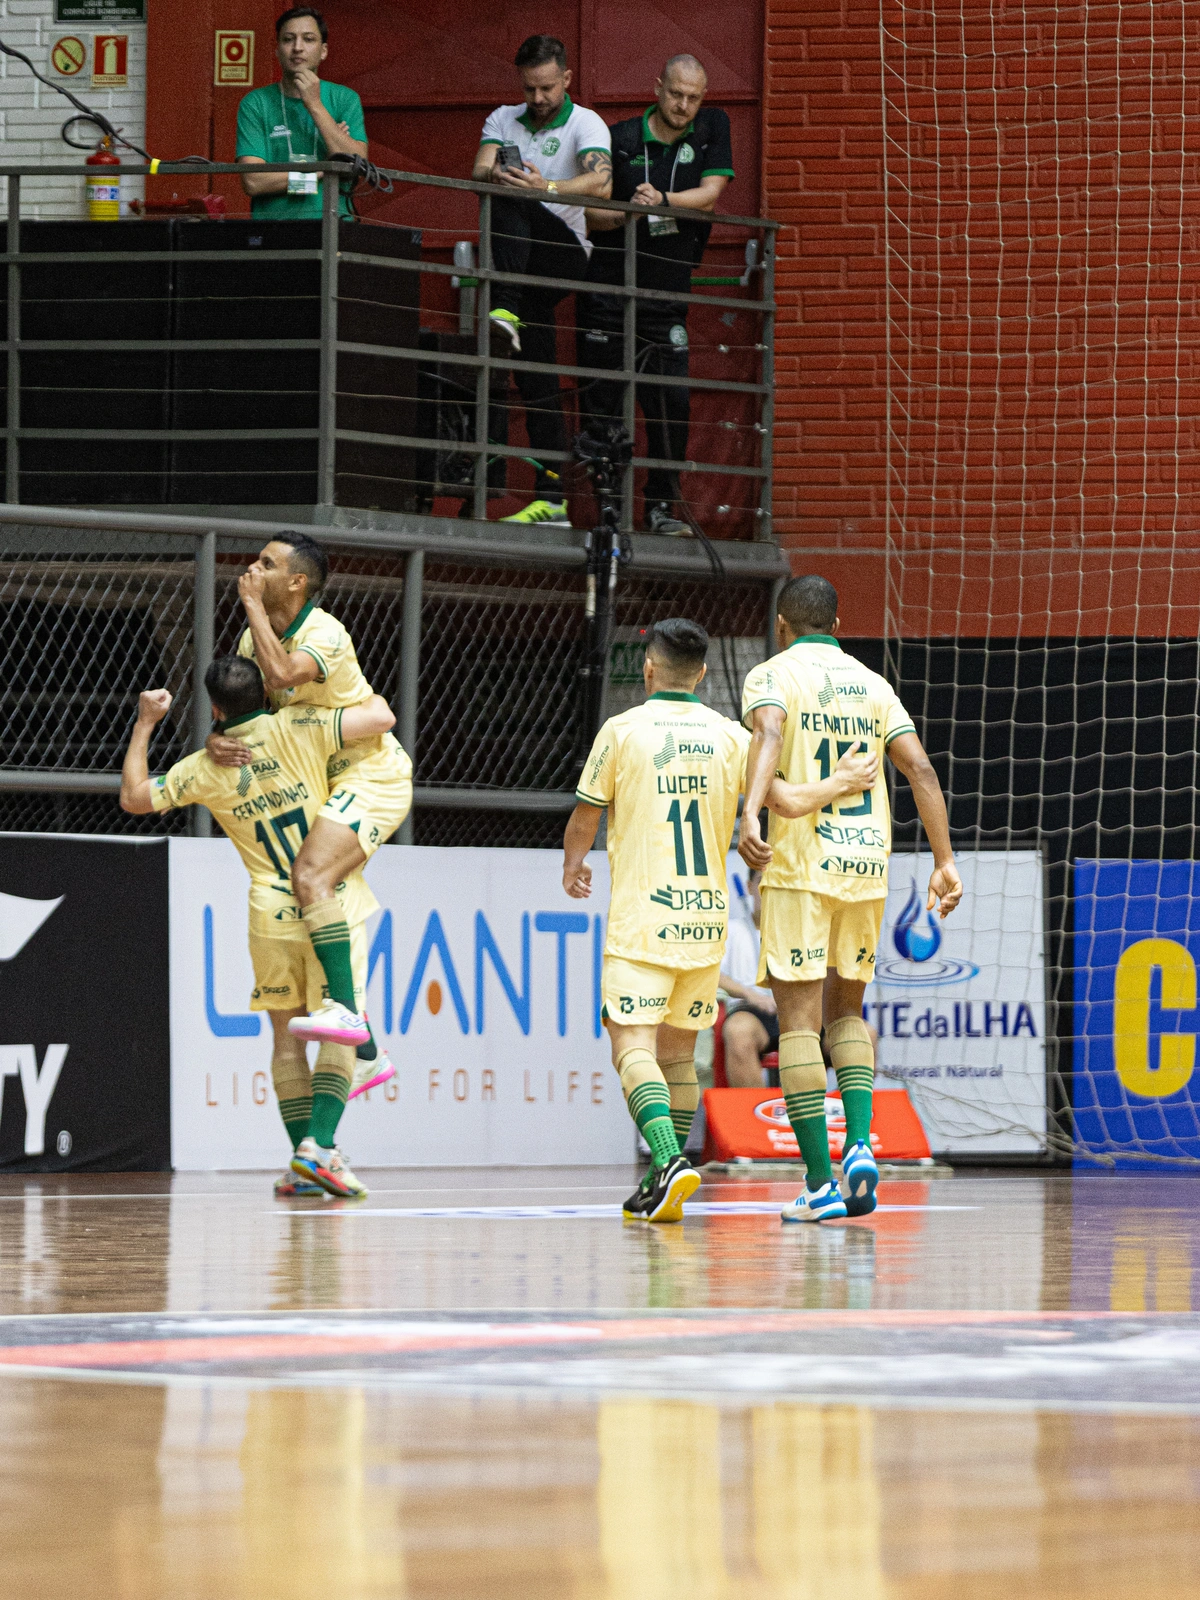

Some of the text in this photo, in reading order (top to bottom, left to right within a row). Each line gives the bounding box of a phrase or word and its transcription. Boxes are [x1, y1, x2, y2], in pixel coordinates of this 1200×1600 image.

[657, 775, 708, 795] LUCAS
[232, 781, 310, 822] FERNANDINHO
[254, 805, 310, 881] 10
[666, 799, 709, 877] 11
[842, 860, 885, 877] POTY
[681, 926, 725, 941] POTY
[946, 1064, 1004, 1078] Natural
[428, 1068, 497, 1103] FOR
[524, 1068, 605, 1105] LIFE
